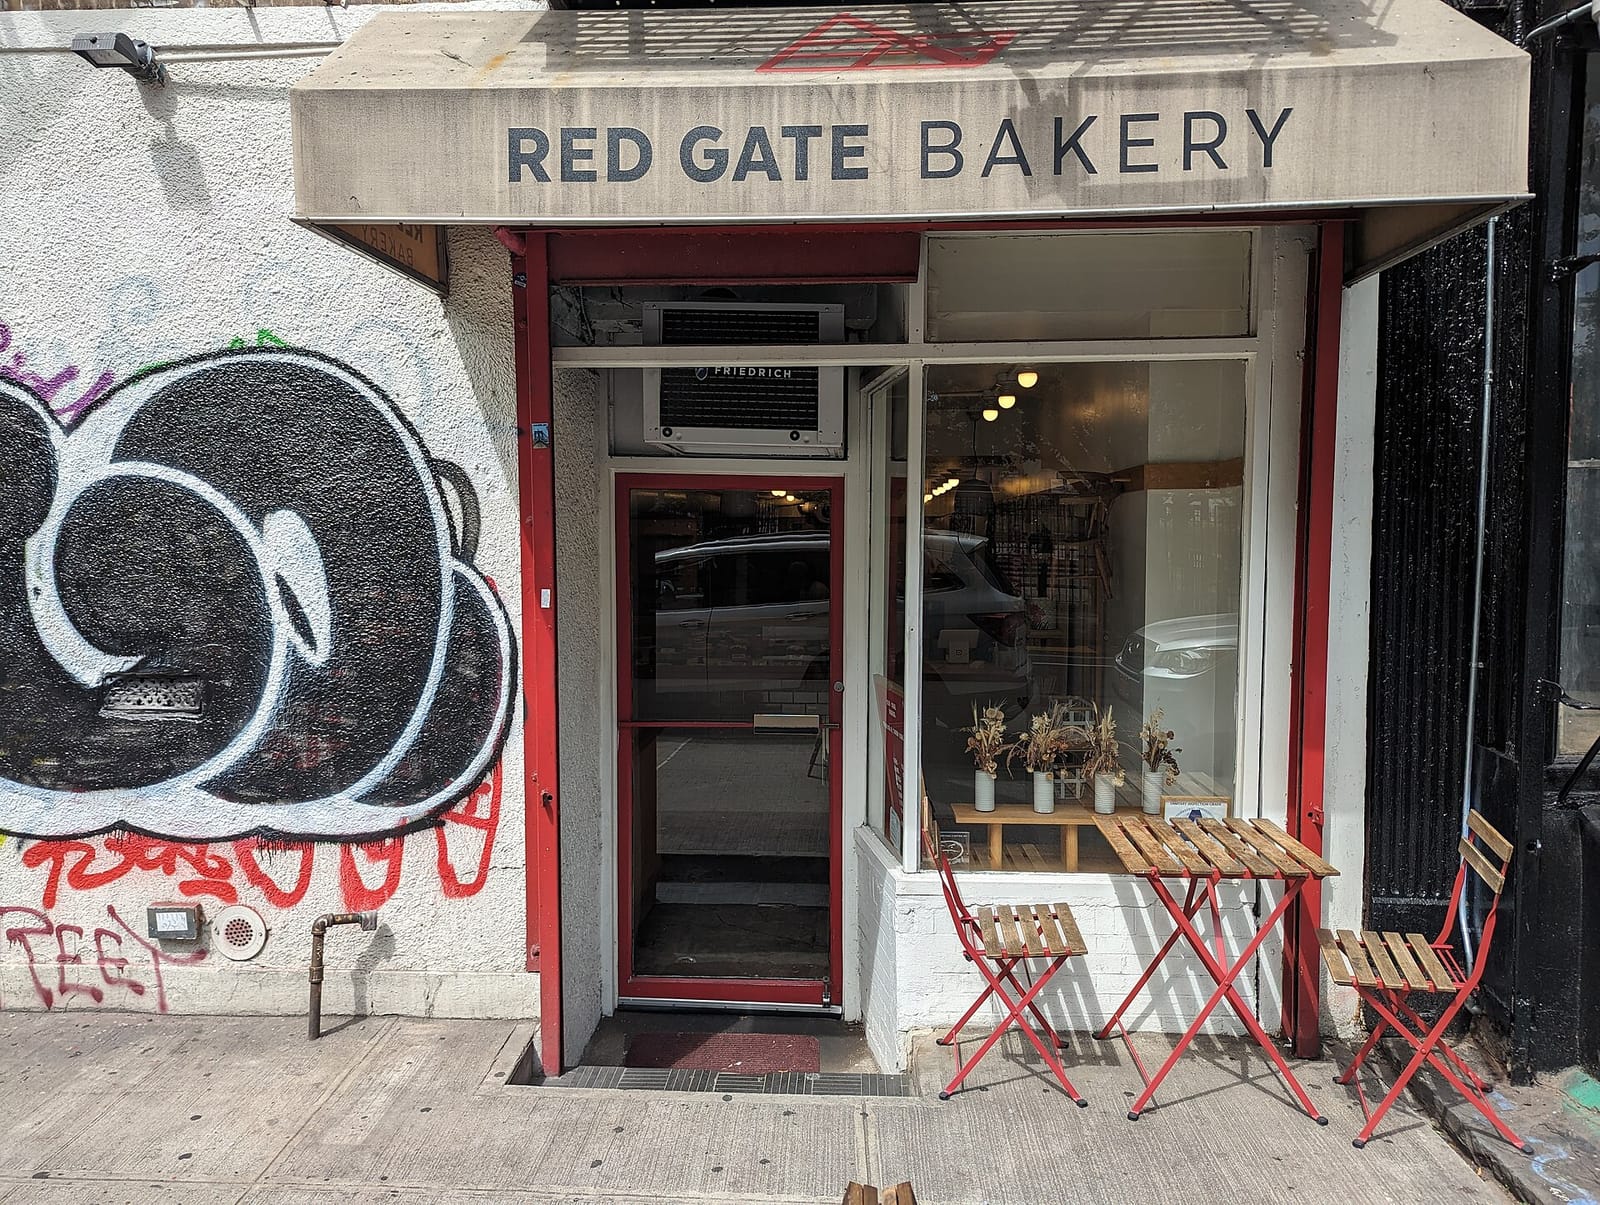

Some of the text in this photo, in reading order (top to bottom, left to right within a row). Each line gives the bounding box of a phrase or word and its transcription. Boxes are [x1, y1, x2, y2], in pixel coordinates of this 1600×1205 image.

[507, 107, 1294, 183] RED GATE BAKERY
[715, 367, 791, 379] FRIEDRICH
